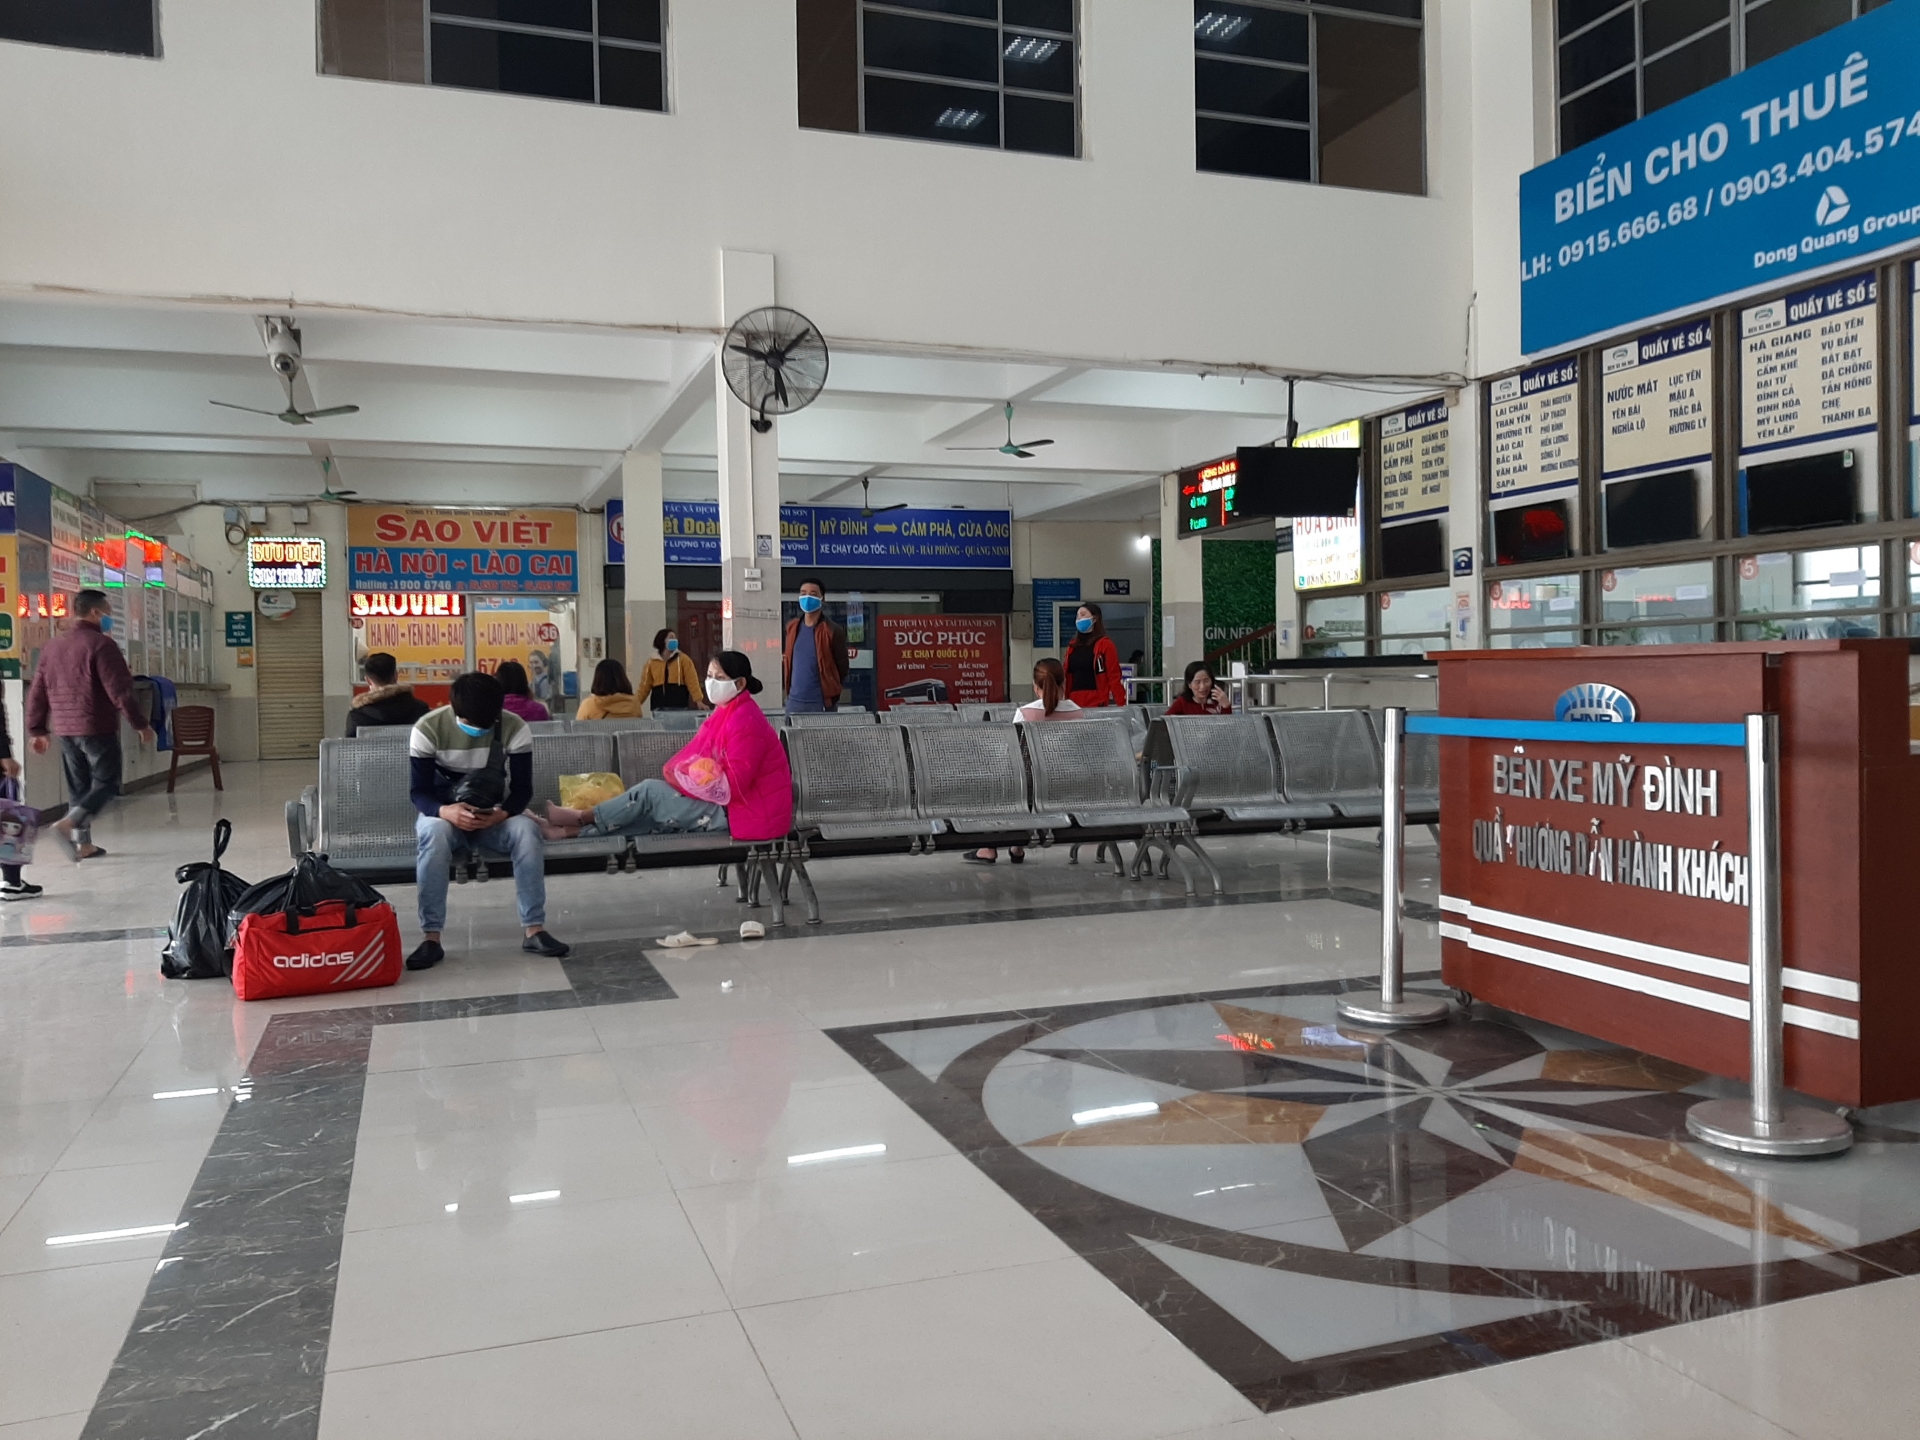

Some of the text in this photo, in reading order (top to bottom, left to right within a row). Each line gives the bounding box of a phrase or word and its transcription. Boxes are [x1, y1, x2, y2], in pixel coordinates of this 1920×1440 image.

[1554, 51, 1869, 224] BIỂN CHO THUÊ
[1521, 110, 1920, 282] LH: 0915.666.68 0903.404.574
[1754, 241, 1797, 269] Dong
[1801, 223, 1860, 254] Quang
[1847, 280, 1866, 304] SỐ
[1869, 282, 1877, 298] 5
[1688, 325, 1703, 347] SỐ
[1750, 328, 1812, 353] HÀ GIANG
[1561, 363, 1573, 382] SỐ
[1669, 373, 1684, 388] LỤC
[1607, 383, 1634, 403] NƯỚC
[1689, 387, 1695, 398] A
[1495, 401, 1529, 418] LAI CHÂU
[1774, 411, 1799, 424] LUNG
[1821, 406, 1872, 425] THANH BA
[1495, 478, 1516, 490] SAPA
[375, 513, 462, 543] SAO
[820, 517, 837, 535] MỸ
[840, 517, 868, 535] ĐÌNH
[985, 520, 1009, 538] ÔNG
[852, 544, 869, 554] CAO
[355, 548, 572, 579] HÀ NỘI LÀO CAI
[1744, 559, 1754, 576] 5
[424, 580, 452, 590] 6746
[541, 625, 558, 640] 36
[894, 629, 986, 646] ĐỨC PHÚC
[1549, 758, 1585, 803] XE
[1592, 753, 1636, 808] MỸ
[1643, 755, 1718, 817] ĐÌNH
[1617, 830, 1673, 893] HÀNH
[1677, 840, 1749, 907] KHÁCH
[273, 951, 355, 969] adidas
